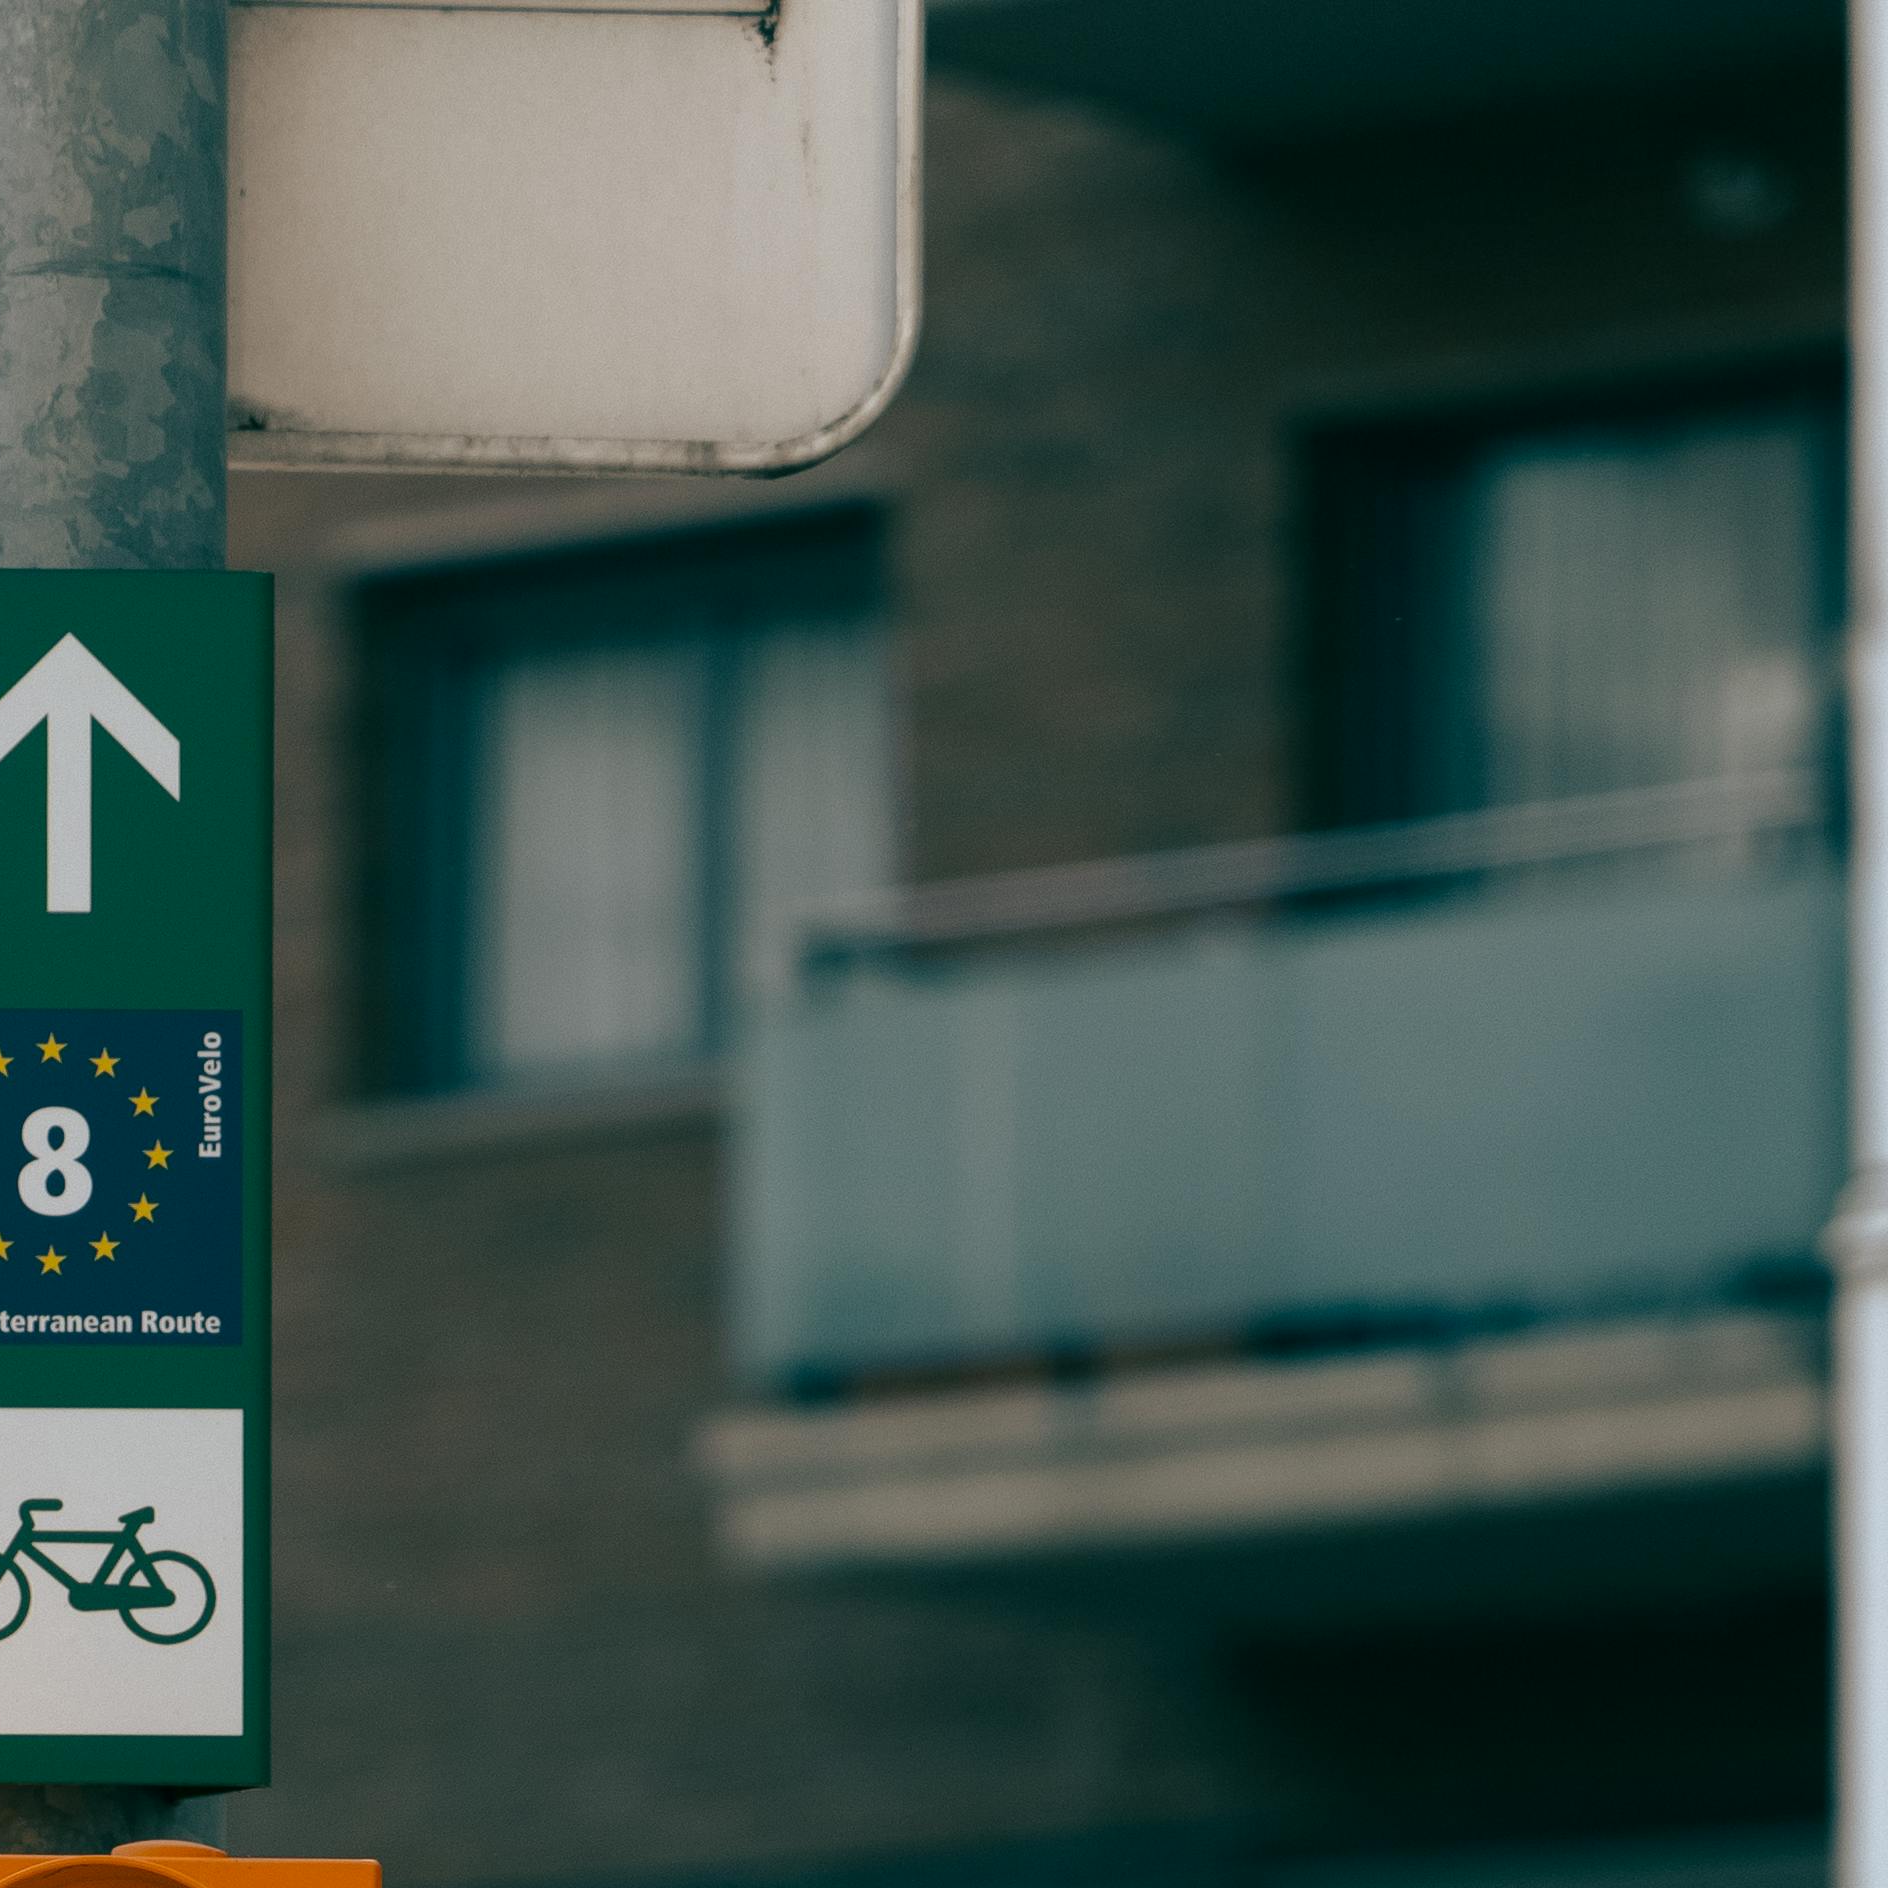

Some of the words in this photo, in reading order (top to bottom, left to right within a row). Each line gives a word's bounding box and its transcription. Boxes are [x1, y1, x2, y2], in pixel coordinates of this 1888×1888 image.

[197, 1031, 222, 1158] EuroVelo
[17, 1106, 93, 1217] 8
[141, 1309, 222, 1334] Route
